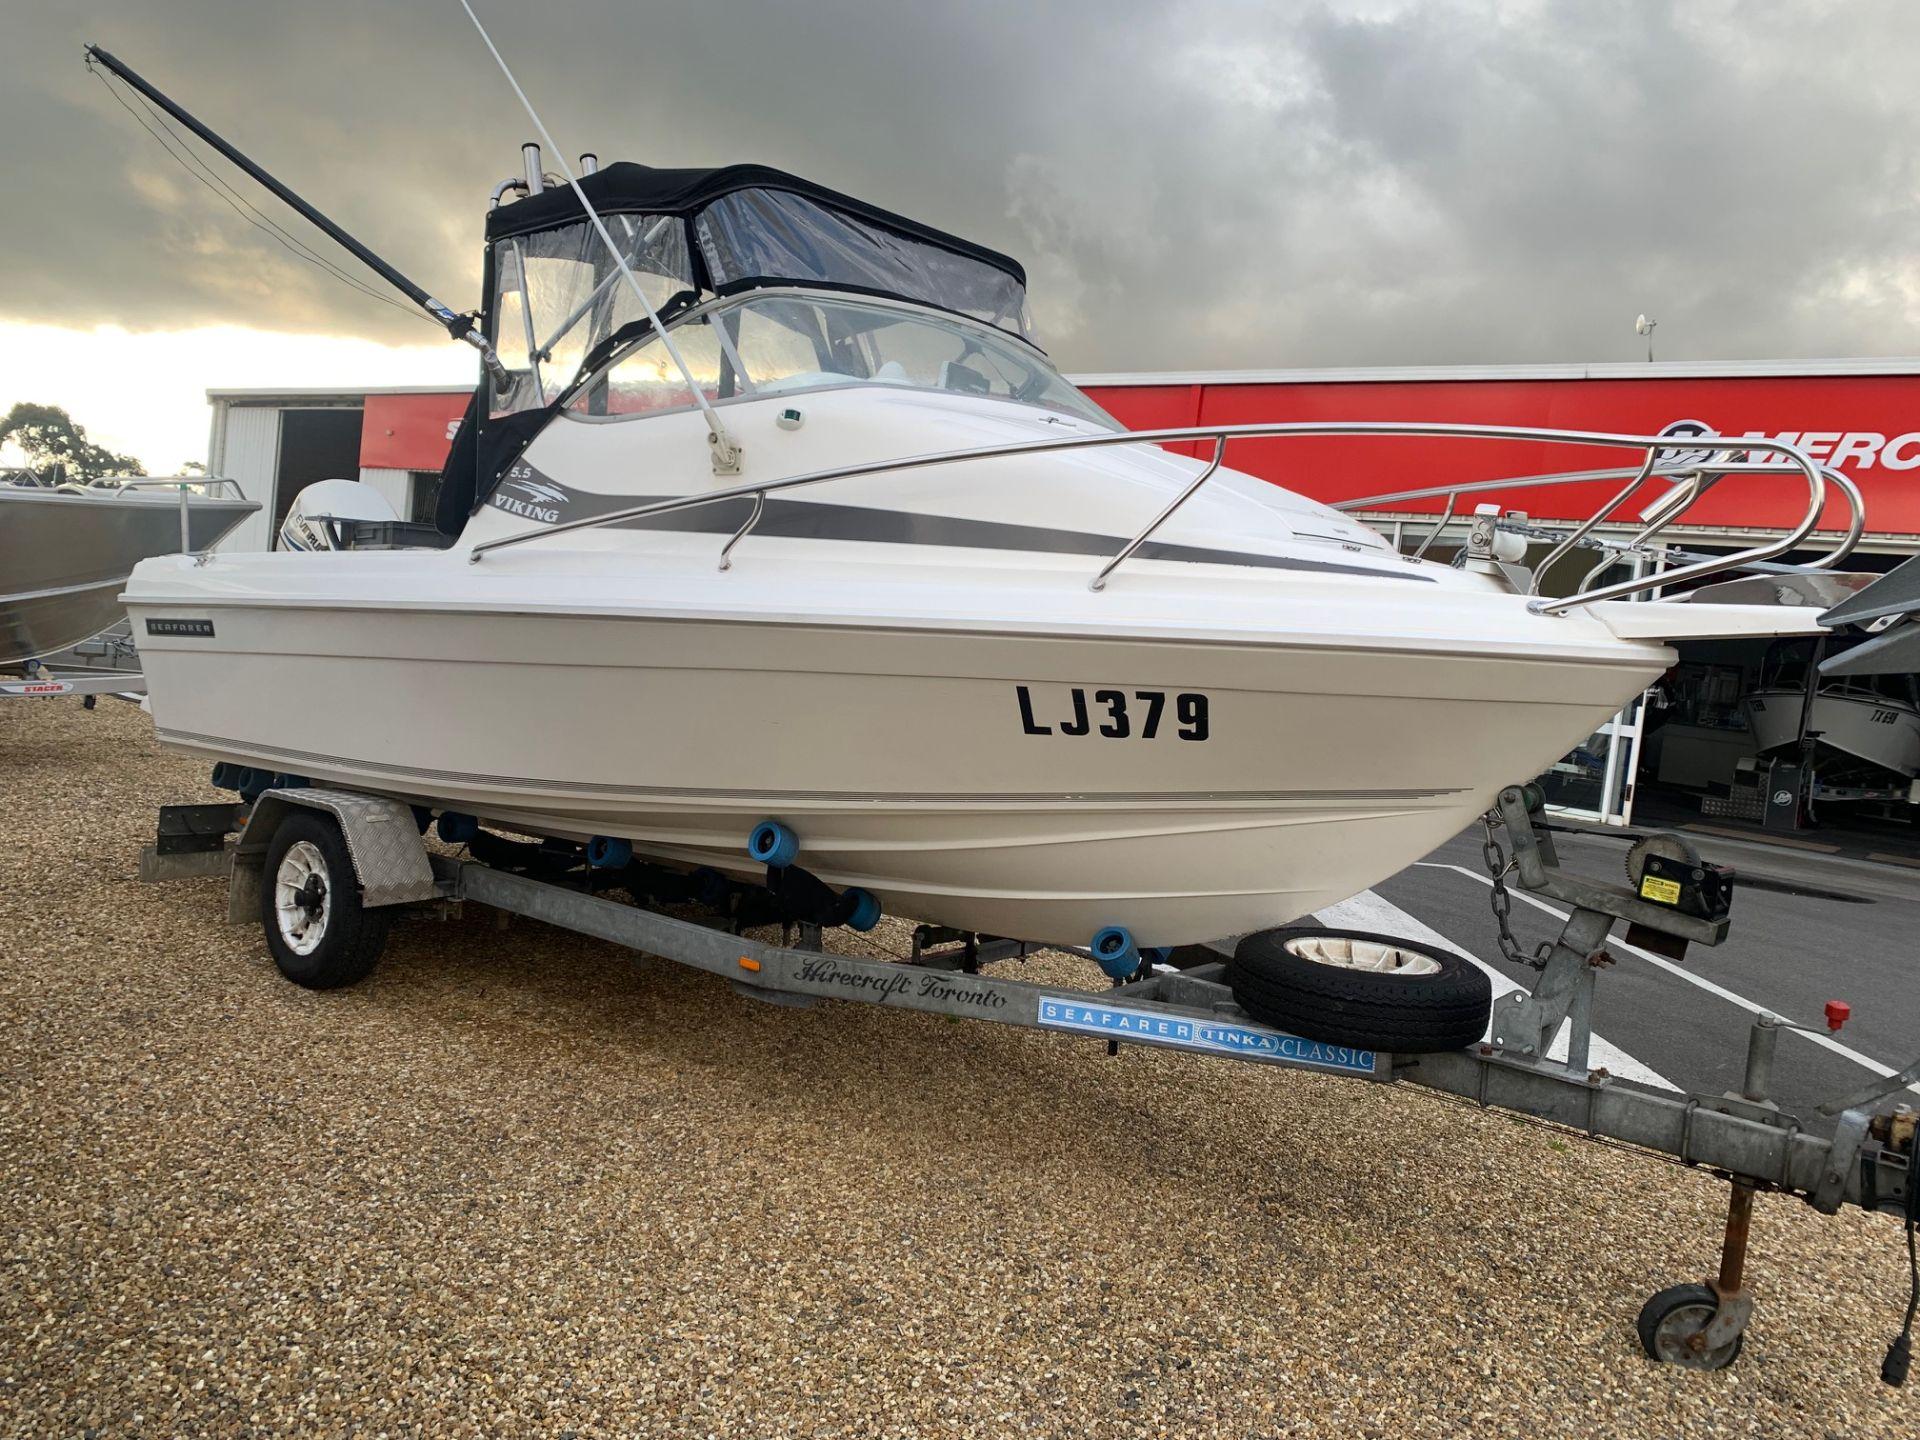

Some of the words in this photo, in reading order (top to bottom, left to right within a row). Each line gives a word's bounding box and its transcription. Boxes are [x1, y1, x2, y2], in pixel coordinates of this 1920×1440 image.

[510, 467, 532, 479] 5.5
[495, 494, 560, 522] VIKING
[24, 685, 63, 693] STACER
[1016, 686, 1209, 741] LJ379
[794, 957, 911, 1002] Hirecraft
[917, 974, 1007, 1009] Toronto
[1047, 1006, 1189, 1036] SEAFARER
[1205, 1029, 1272, 1048] TINKA
[1280, 1039, 1372, 1067] CLASSIC
